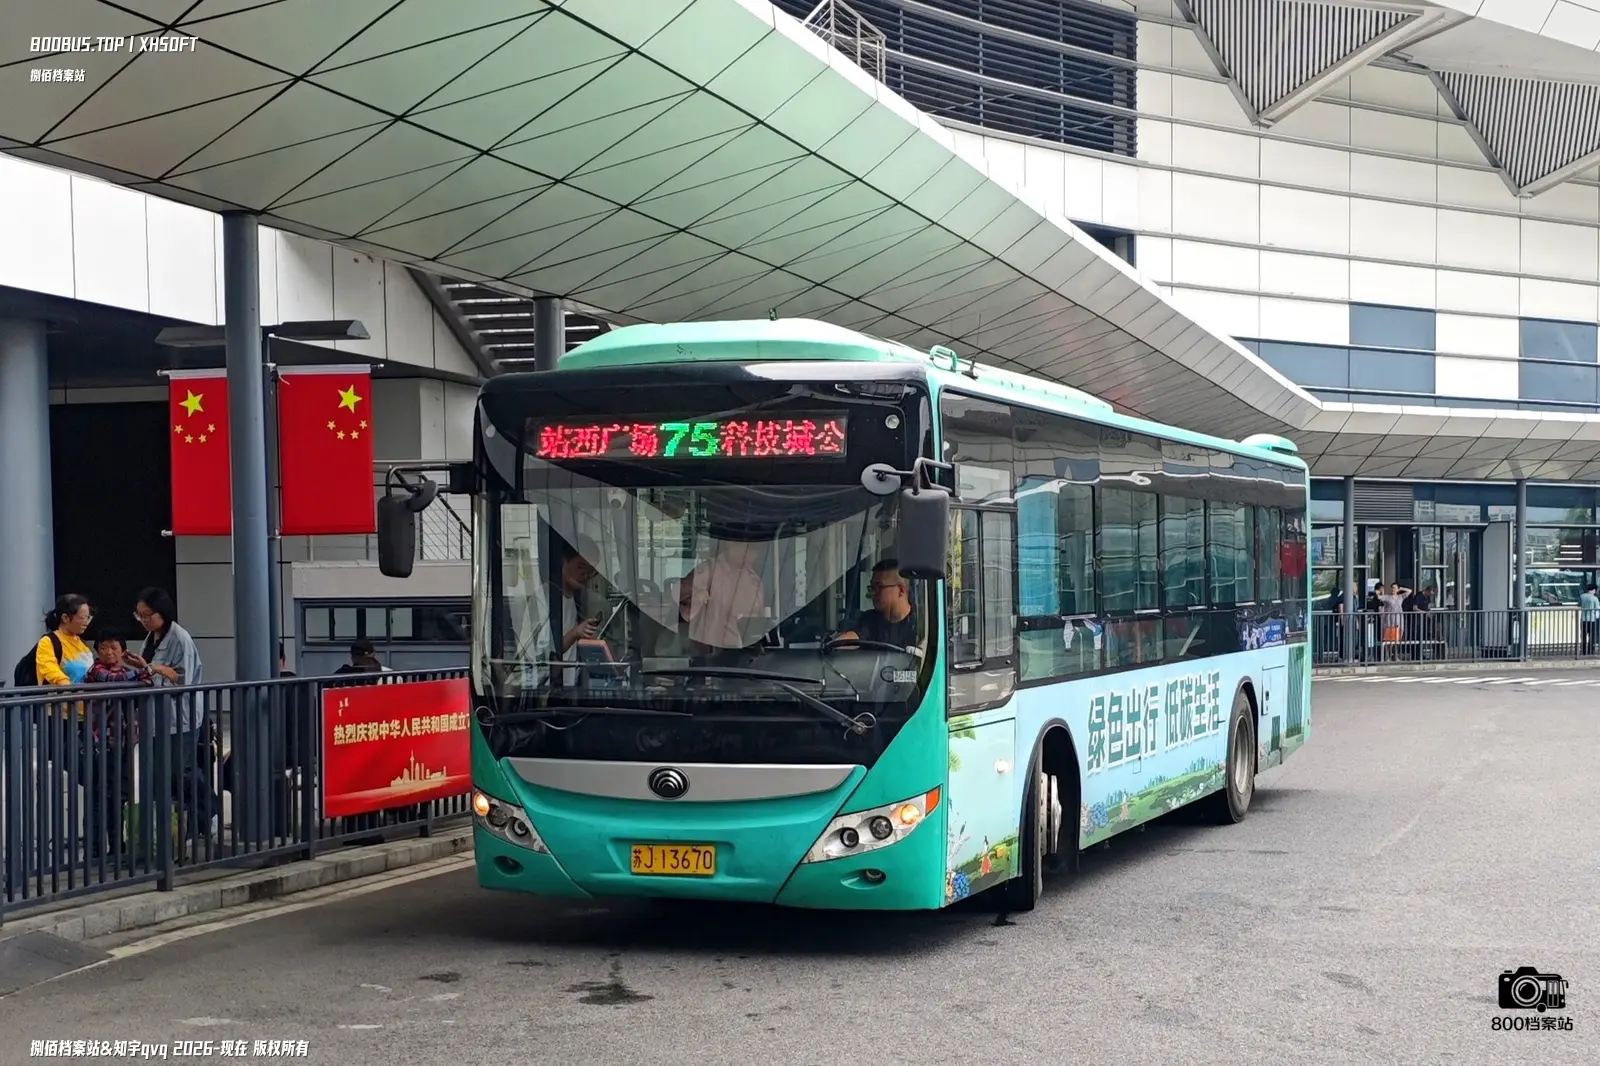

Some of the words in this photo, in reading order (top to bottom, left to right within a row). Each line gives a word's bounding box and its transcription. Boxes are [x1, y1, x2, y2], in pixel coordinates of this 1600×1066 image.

[536, 422, 659, 458] 站西广场
[659, 421, 721, 457] 75
[719, 419, 845, 456] 科技城公
[1086, 685, 1160, 775] 绿色出行
[1163, 669, 1221, 751] 低碳生活
[632, 847, 713, 870] 苏J13670
